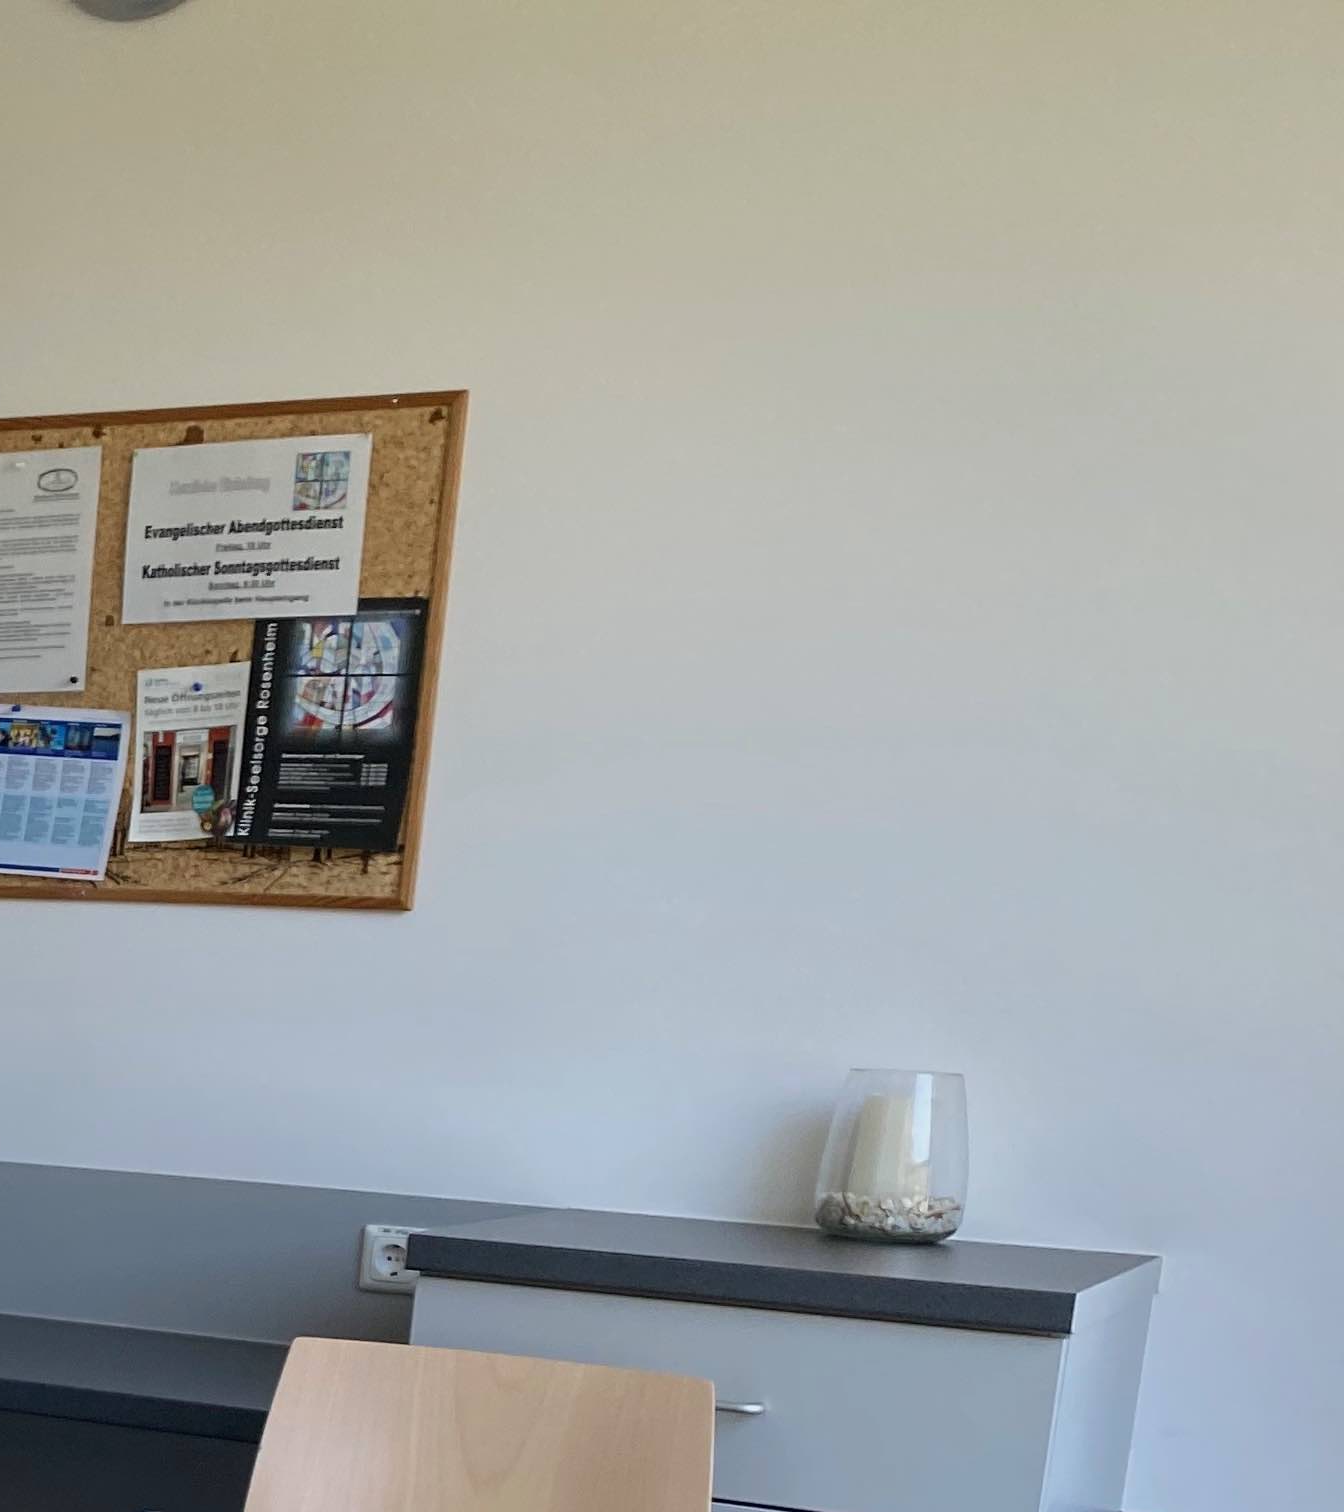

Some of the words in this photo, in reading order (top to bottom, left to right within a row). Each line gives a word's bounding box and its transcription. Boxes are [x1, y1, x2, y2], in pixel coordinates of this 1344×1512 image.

[145, 521, 226, 540] Evangelischer
[228, 515, 344, 535] Abendgottesdienst
[142, 560, 211, 579] Katholischer
[214, 556, 340, 576] Sonntagsgottesdienst
[237, 715, 267, 836] Klinik-Seelsorge
[256, 622, 279, 709] Rosenheim
